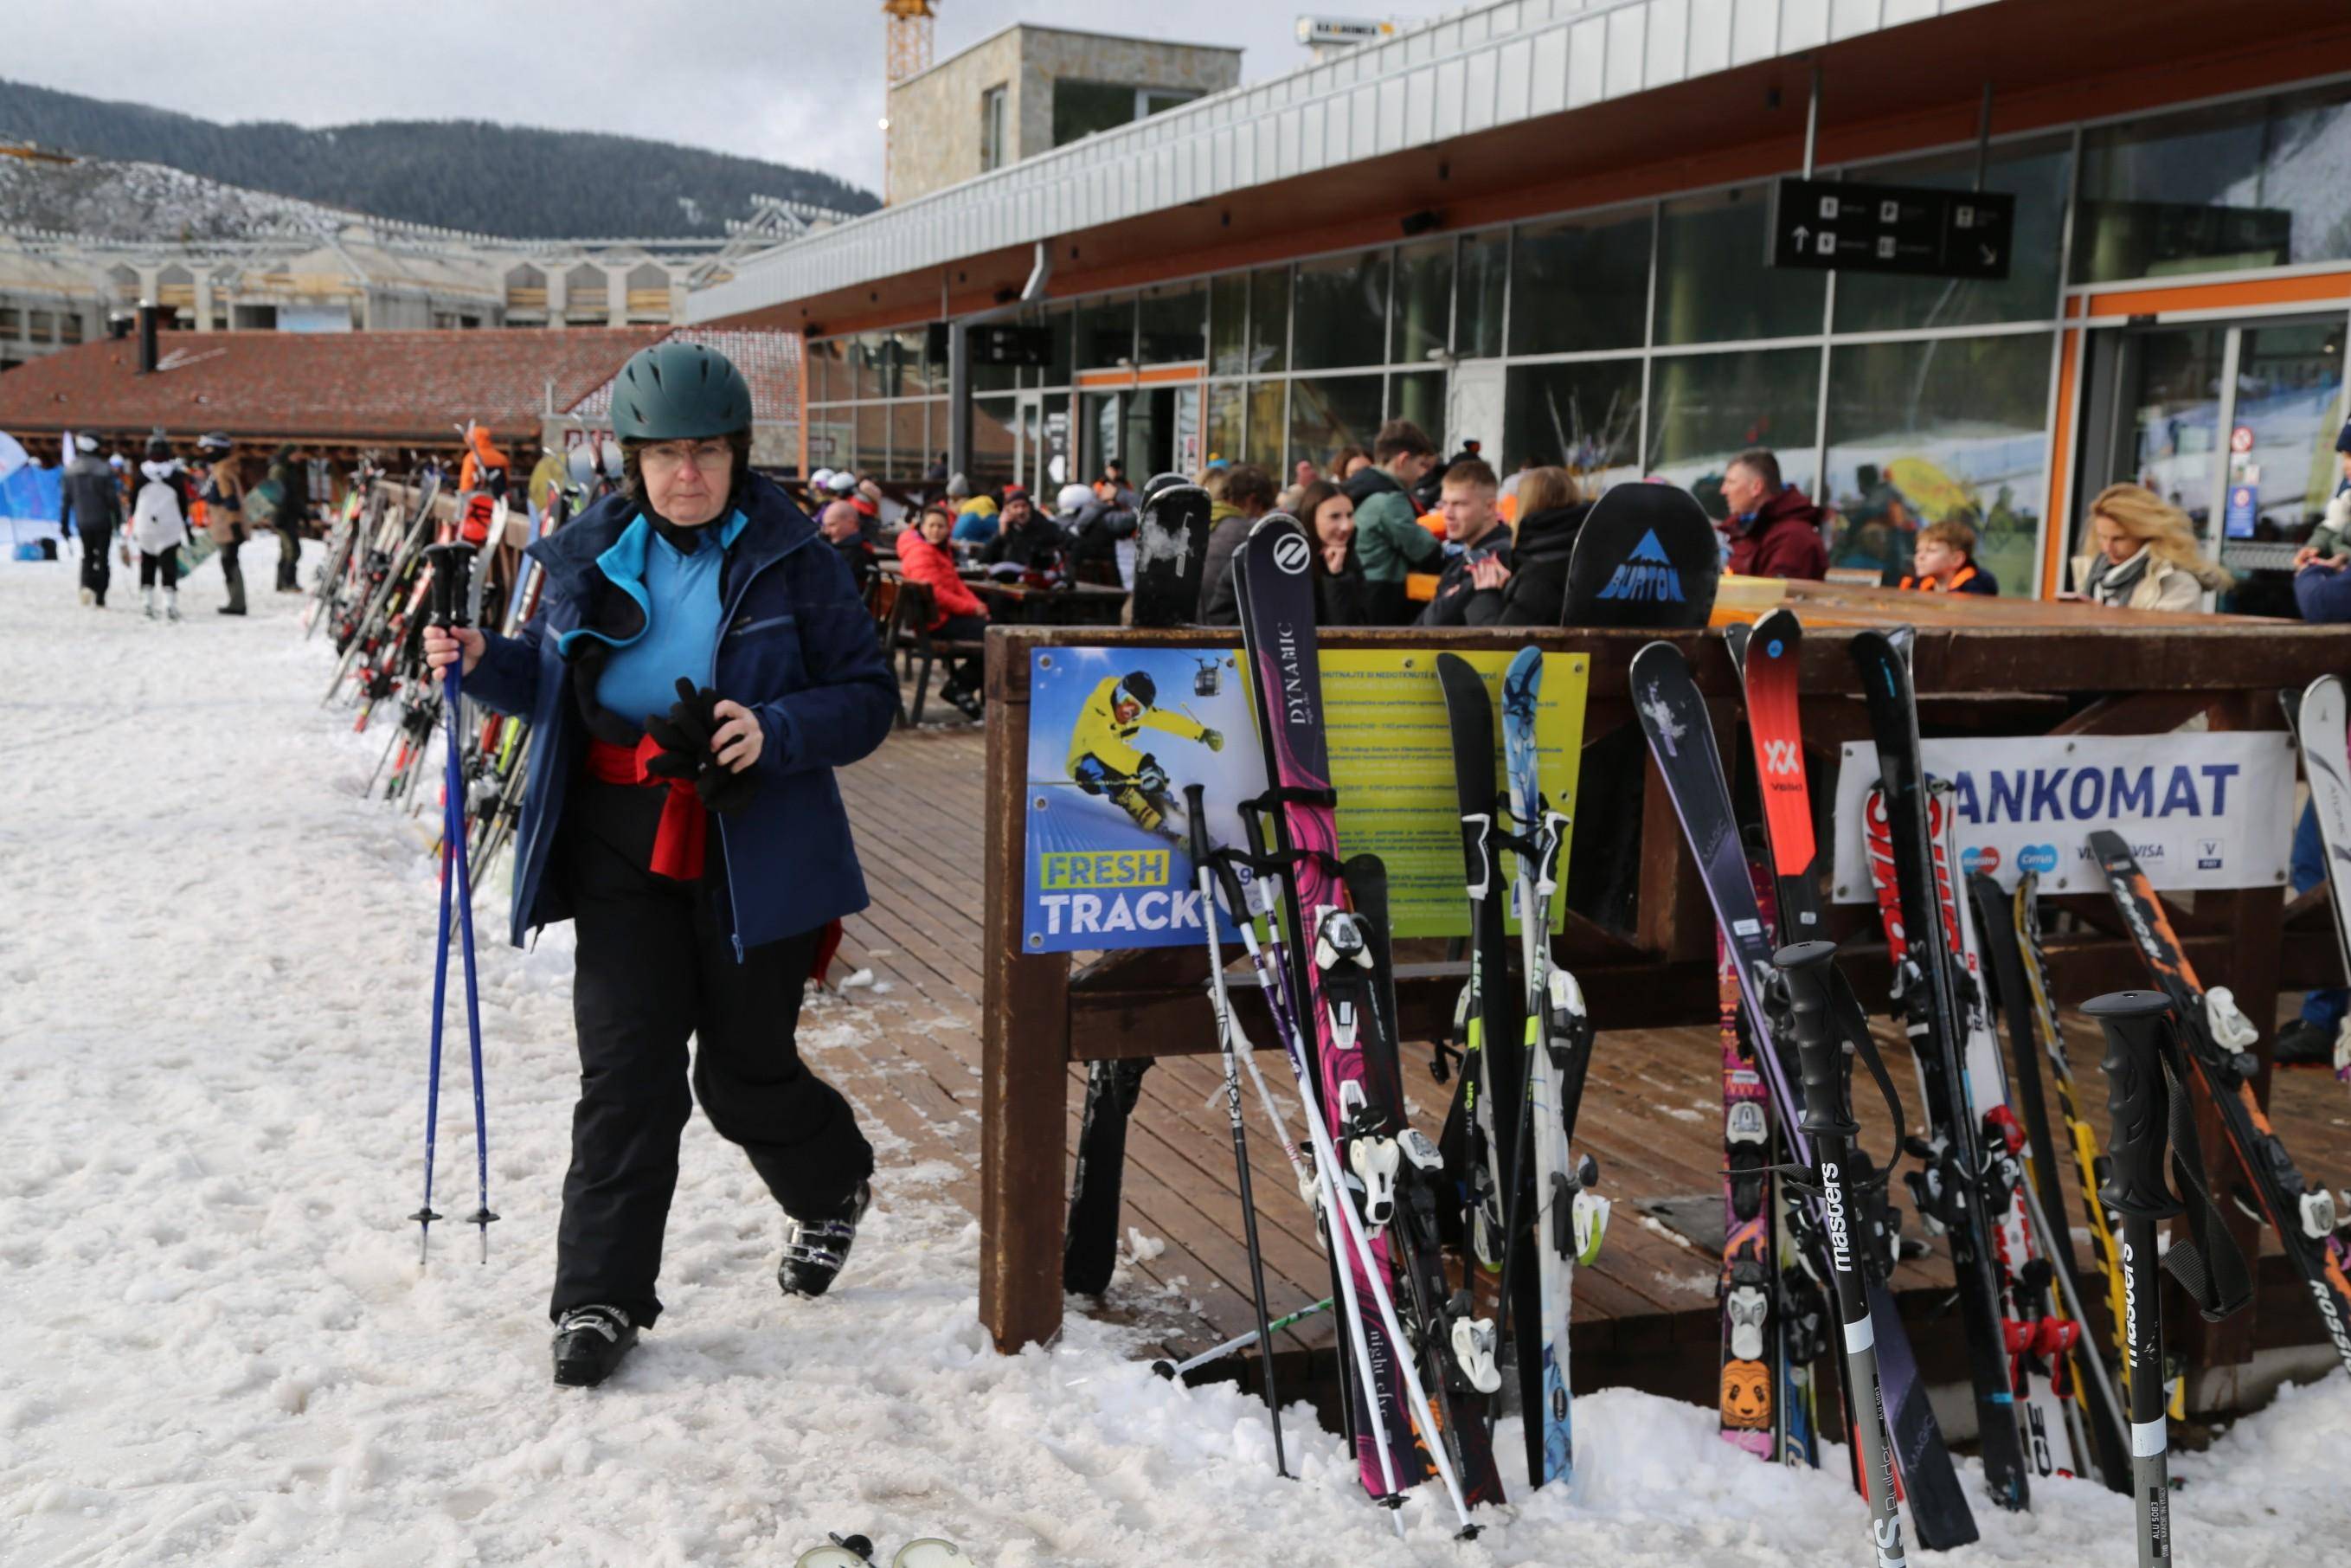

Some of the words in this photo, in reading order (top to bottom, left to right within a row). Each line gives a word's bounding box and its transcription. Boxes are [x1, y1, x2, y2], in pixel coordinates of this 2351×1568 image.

[1595, 563, 1687, 602] BURTON
[1278, 622, 1306, 723] DYNAMIC
[1924, 764, 2239, 824] ANKOMAT
[1047, 854, 1163, 885] FRESH
[2133, 845, 2165, 858] VISA
[1039, 890, 1203, 935] TRACK
[1473, 949, 1481, 997] LEKI
[1532, 944, 1545, 992] LEKI
[1821, 1162, 1852, 1271] masters
[1368, 1330, 1388, 1374] night
[2150, 1501, 2159, 1522] 5083
